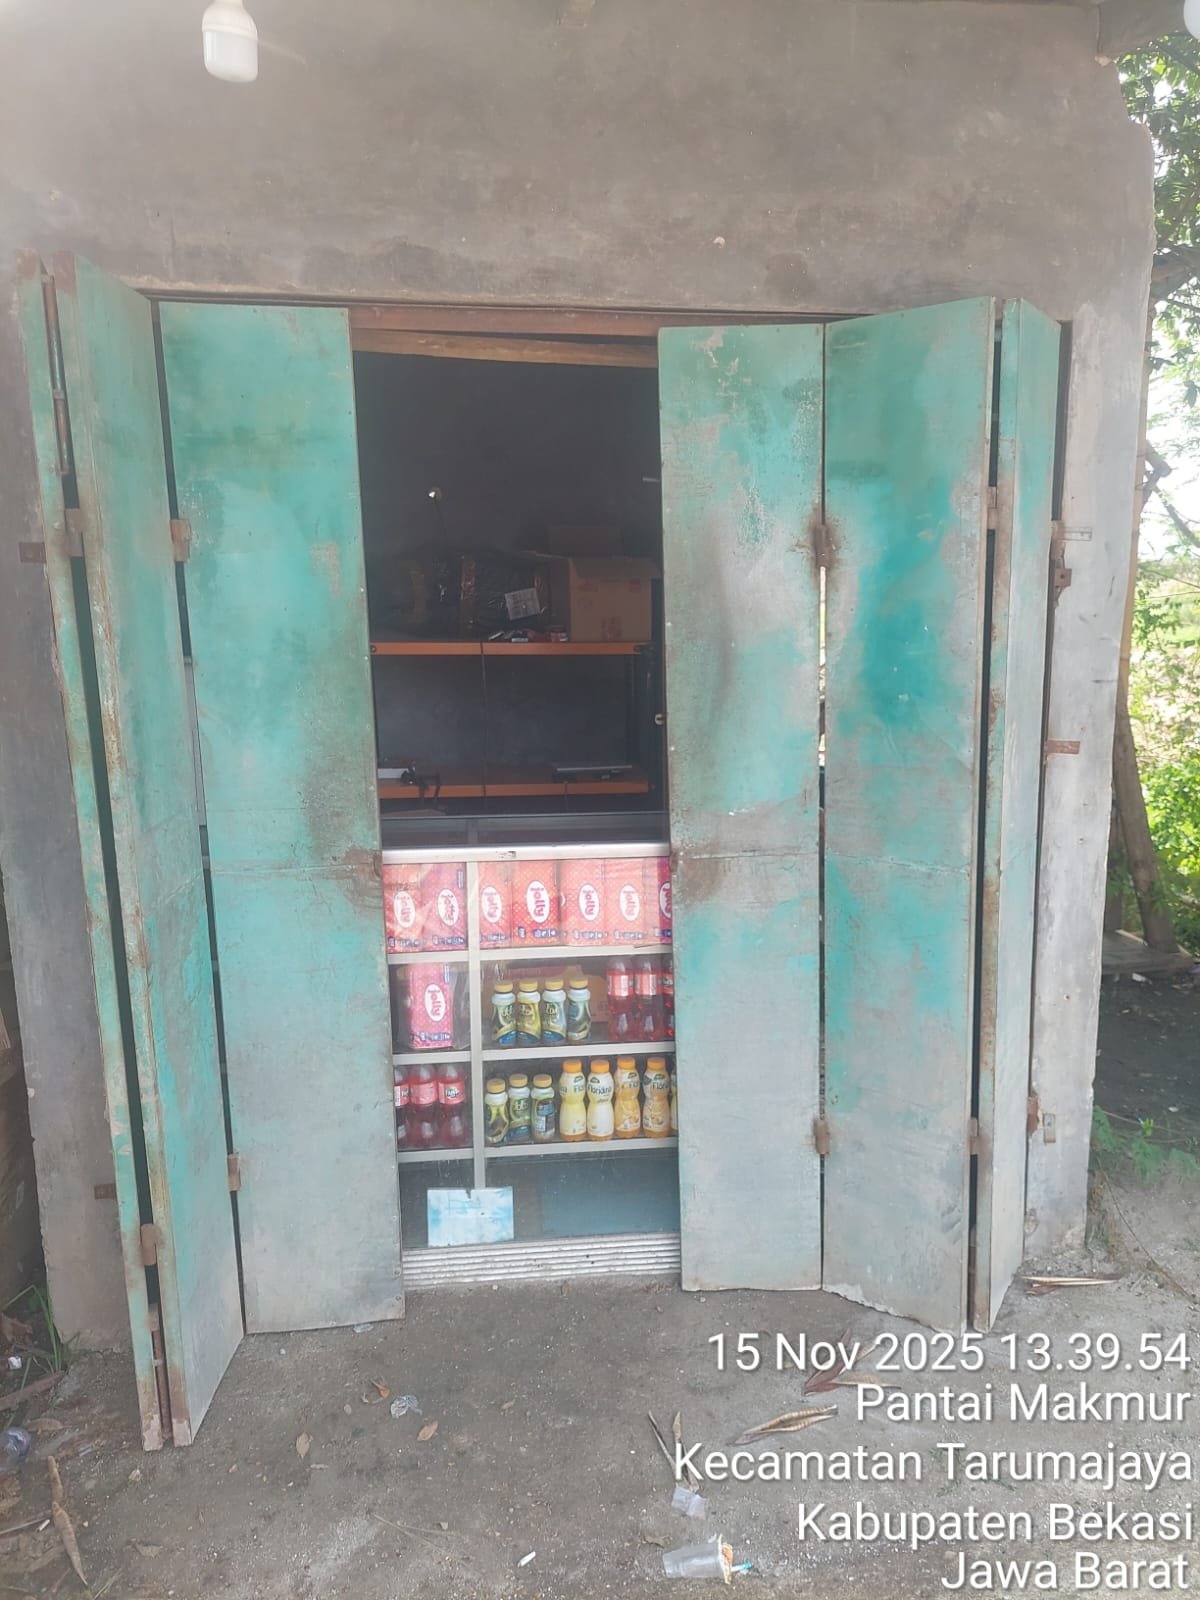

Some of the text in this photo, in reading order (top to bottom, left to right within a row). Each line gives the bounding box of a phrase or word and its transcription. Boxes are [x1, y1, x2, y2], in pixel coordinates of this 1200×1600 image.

[484, 891, 498, 918] jolly
[530, 886, 545, 917] jolly
[583, 889, 596, 916] jolly
[622, 890, 636, 916] jolly
[428, 989, 442, 1016] jolly
